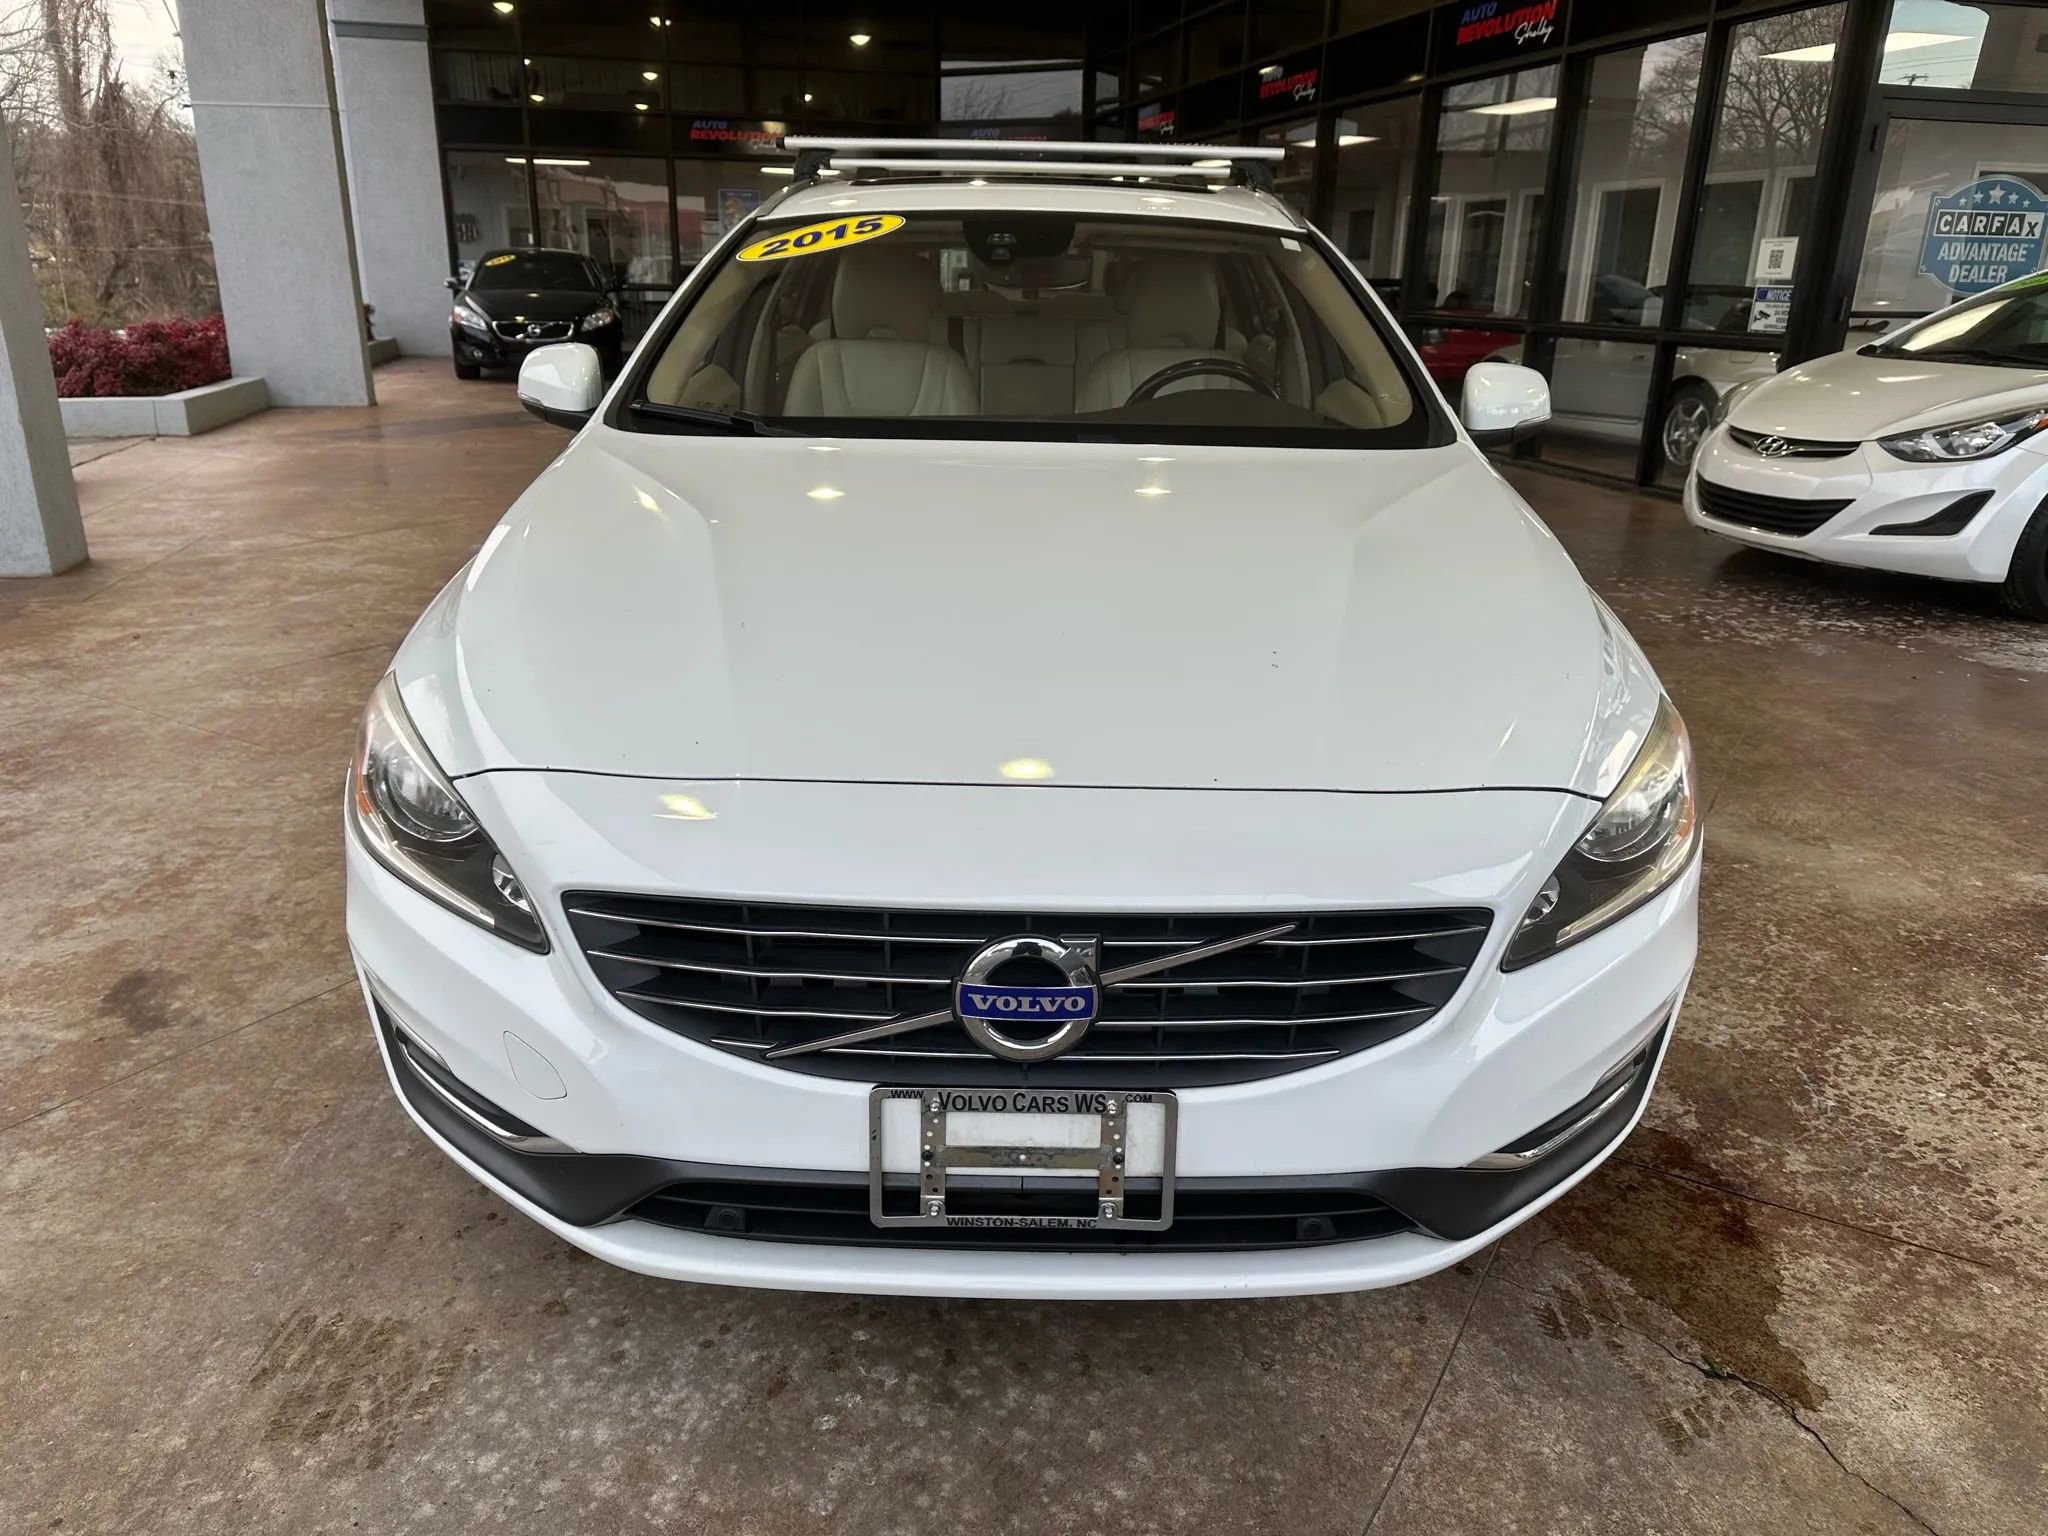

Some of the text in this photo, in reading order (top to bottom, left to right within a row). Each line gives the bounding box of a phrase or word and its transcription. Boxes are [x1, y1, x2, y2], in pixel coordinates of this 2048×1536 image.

[1456, 0, 1558, 45] REVOLUTION
[1461, 2, 1497, 24] AUTO
[1514, 16, 1554, 45] Shelby
[692, 120, 727, 129] AUTO
[1939, 213, 2039, 237] CARFAX
[758, 217, 884, 258] 2015
[1948, 264, 2008, 283] DEALER
[968, 993, 1086, 1012] VOLVO
[938, 1091, 1007, 1112] VOLVO
[1012, 1092, 1069, 1113] CARS
[1074, 1093, 1107, 1113] WS
[1077, 1219, 1097, 1229] NC
